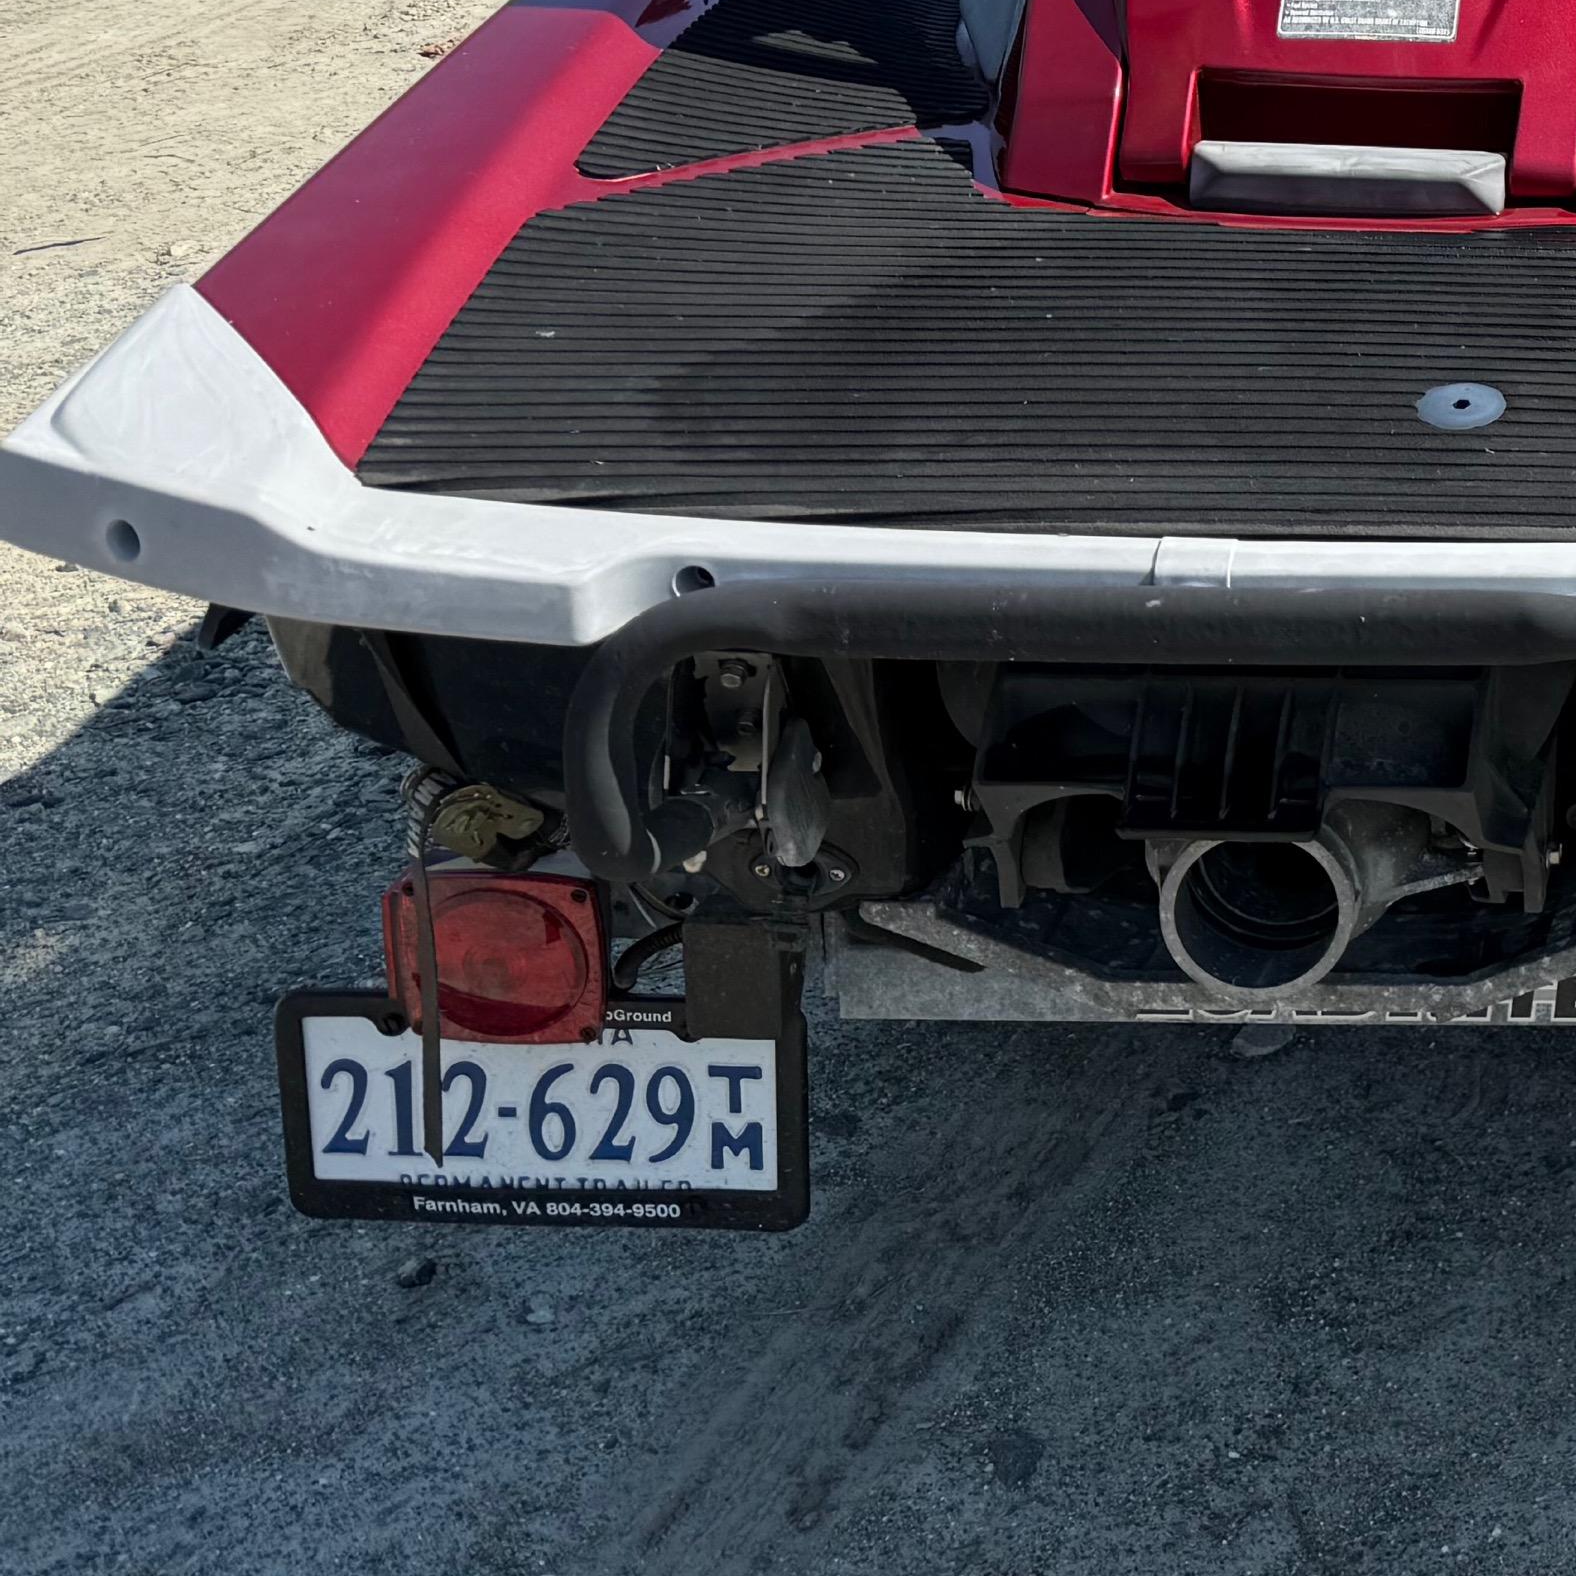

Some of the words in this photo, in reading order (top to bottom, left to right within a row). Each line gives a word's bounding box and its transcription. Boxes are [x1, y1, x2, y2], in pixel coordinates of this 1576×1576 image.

[320, 1057, 695, 1164] 212-629
[413, 1195, 507, 1216] Farnham,
[512, 1200, 541, 1215] VA
[546, 1202, 681, 1218] 804-394-9500
